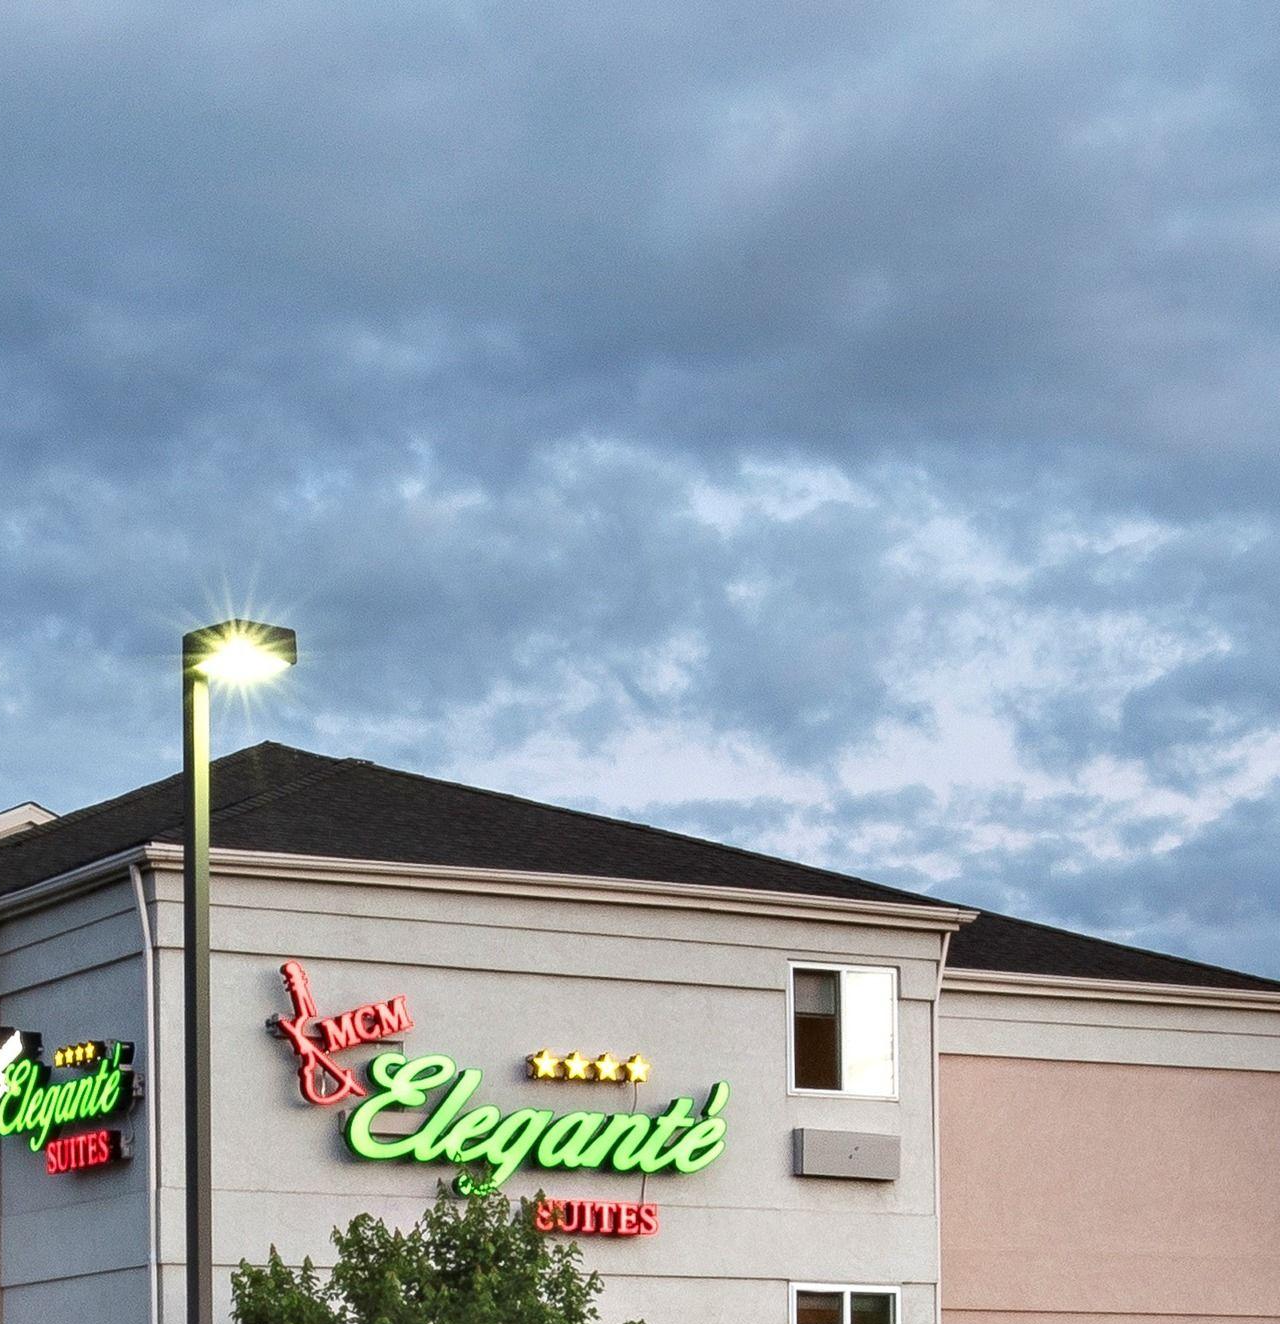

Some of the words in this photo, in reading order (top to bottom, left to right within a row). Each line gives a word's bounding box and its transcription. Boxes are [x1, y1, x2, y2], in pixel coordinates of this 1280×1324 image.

[319, 994, 414, 1052] MCM
[346, 1051, 731, 1197] Eleganté
[46, 1130, 110, 1174] SUITES
[536, 1199, 659, 1236] SUITES
